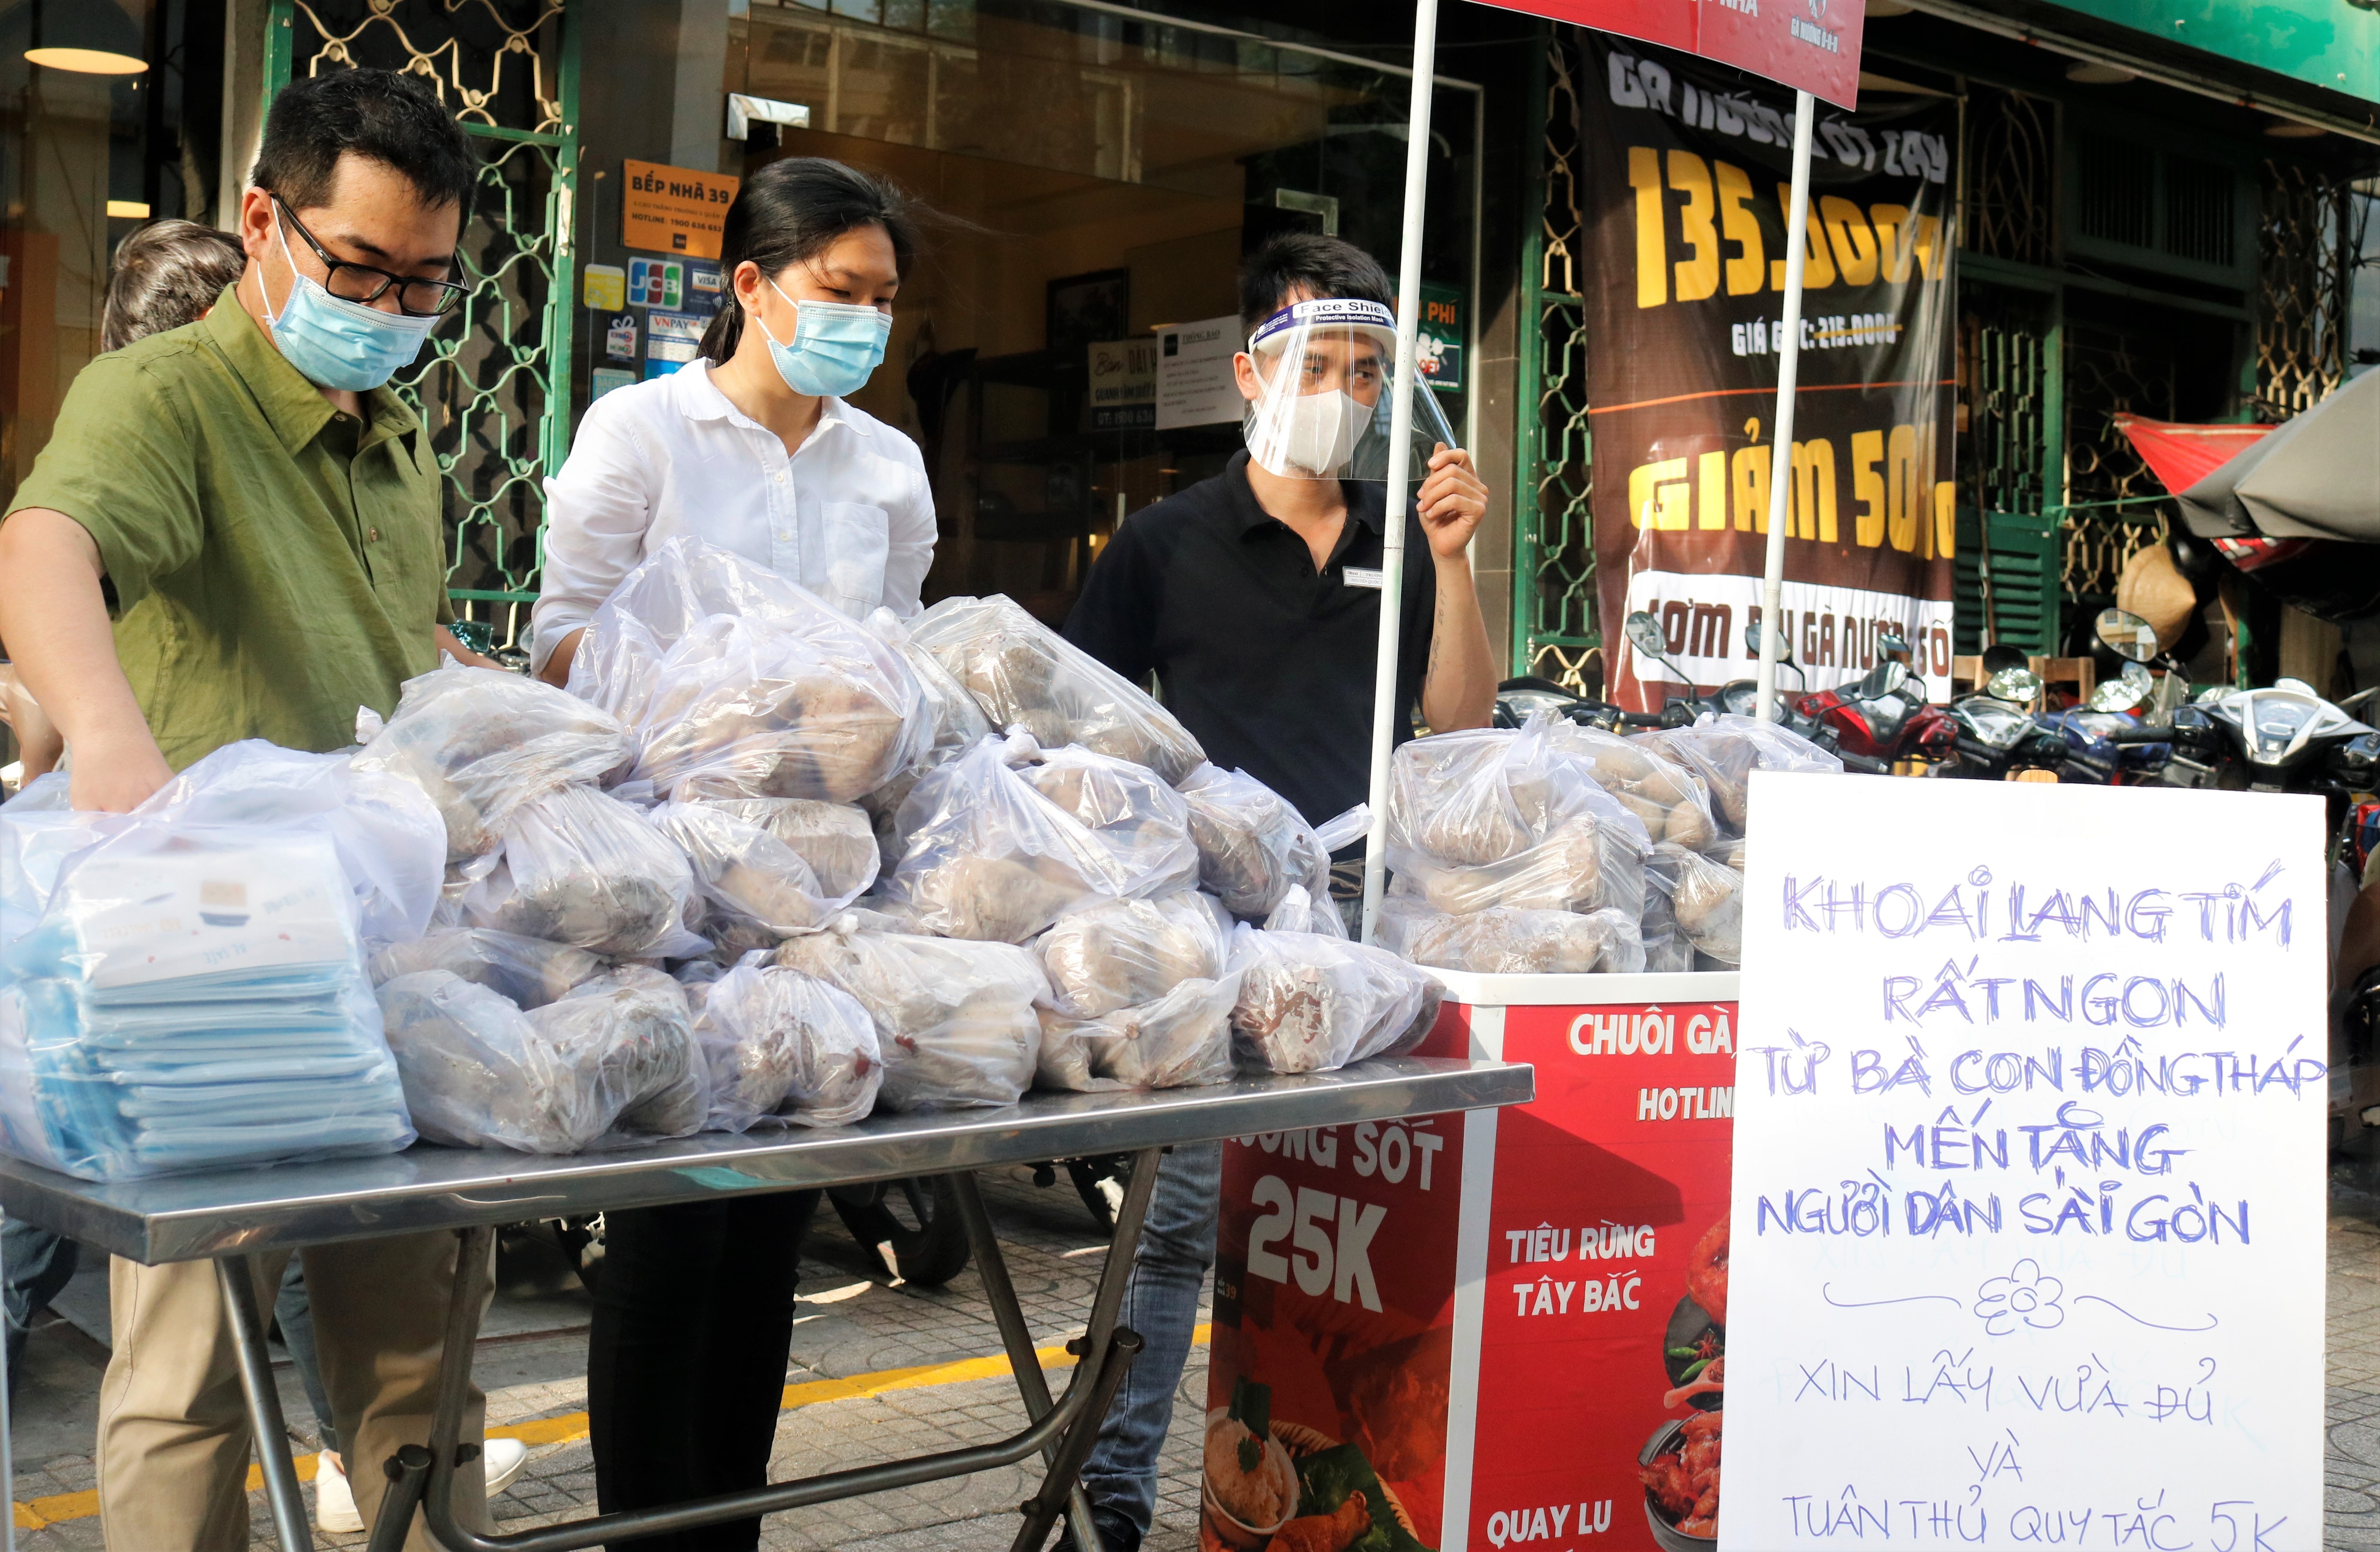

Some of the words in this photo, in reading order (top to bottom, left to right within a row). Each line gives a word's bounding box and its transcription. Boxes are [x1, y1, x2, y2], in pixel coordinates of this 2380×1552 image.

[632, 170, 665, 194] BẾP
[670, 182, 704, 201] NHÀ
[708, 188, 729, 204] 39
[671, 219, 689, 227] 1900
[631, 275, 678, 294] JCB
[697, 275, 716, 286] VISA
[654, 316, 689, 329] VNPAY
[1301, 303, 1342, 314] Face
[1428, 299, 1458, 325] PHÍ
[1731, 316, 1767, 357] GIÁ
[1771, 317, 1816, 353] GC:
[1628, 417, 1838, 543] GIẢM
[1648, 598, 1731, 659] ƠM
[1803, 604, 1835, 667] GÀ
[1998, 881, 2173, 943] LANG
[2179, 858, 2292, 951] TÍM
[1883, 955, 2017, 1027] RẤT
[2024, 973, 2226, 1030] NGON
[1684, 1004, 1732, 1055] GÀ
[1746, 1027, 1831, 1096] TỪ
[1850, 1035, 1932, 1098] BÀ
[1950, 1046, 2063, 1095] CON
[2202, 1034, 2328, 1101] THÁP
[1636, 1087, 1735, 1122] HOTLIN
[1353, 1118, 1443, 1191] SỐT
[1884, 1098, 2009, 1171] MẾN
[1758, 1169, 1892, 1237] NGƯỜI
[1906, 1180, 2002, 1239] DÂN
[2024, 1180, 2123, 1235] SÀI
[2126, 1181, 2250, 1244] GÒN
[1247, 1175, 1387, 1313] 25K
[1505, 1221, 1570, 1263] TIÊU
[1580, 1219, 1655, 1260] RỪNG
[1226, 1283, 1237, 1300] 39
[1513, 1274, 1577, 1316] TÂY
[1583, 1270, 1642, 1312] BẮC
[1795, 1358, 1881, 1402] XIN
[2143, 1357, 2216, 1425] ĐỦ
[1967, 1429, 2023, 1482] VÀ
[1487, 1504, 1571, 1550] QUAY
[1578, 1499, 1612, 1535] LU
[1783, 1484, 1890, 1540] TUÂN
[1899, 1485, 1987, 1544] THỦ
[2010, 1506, 2092, 1545] QUY
[2102, 1488, 2193, 1552] TẮC
